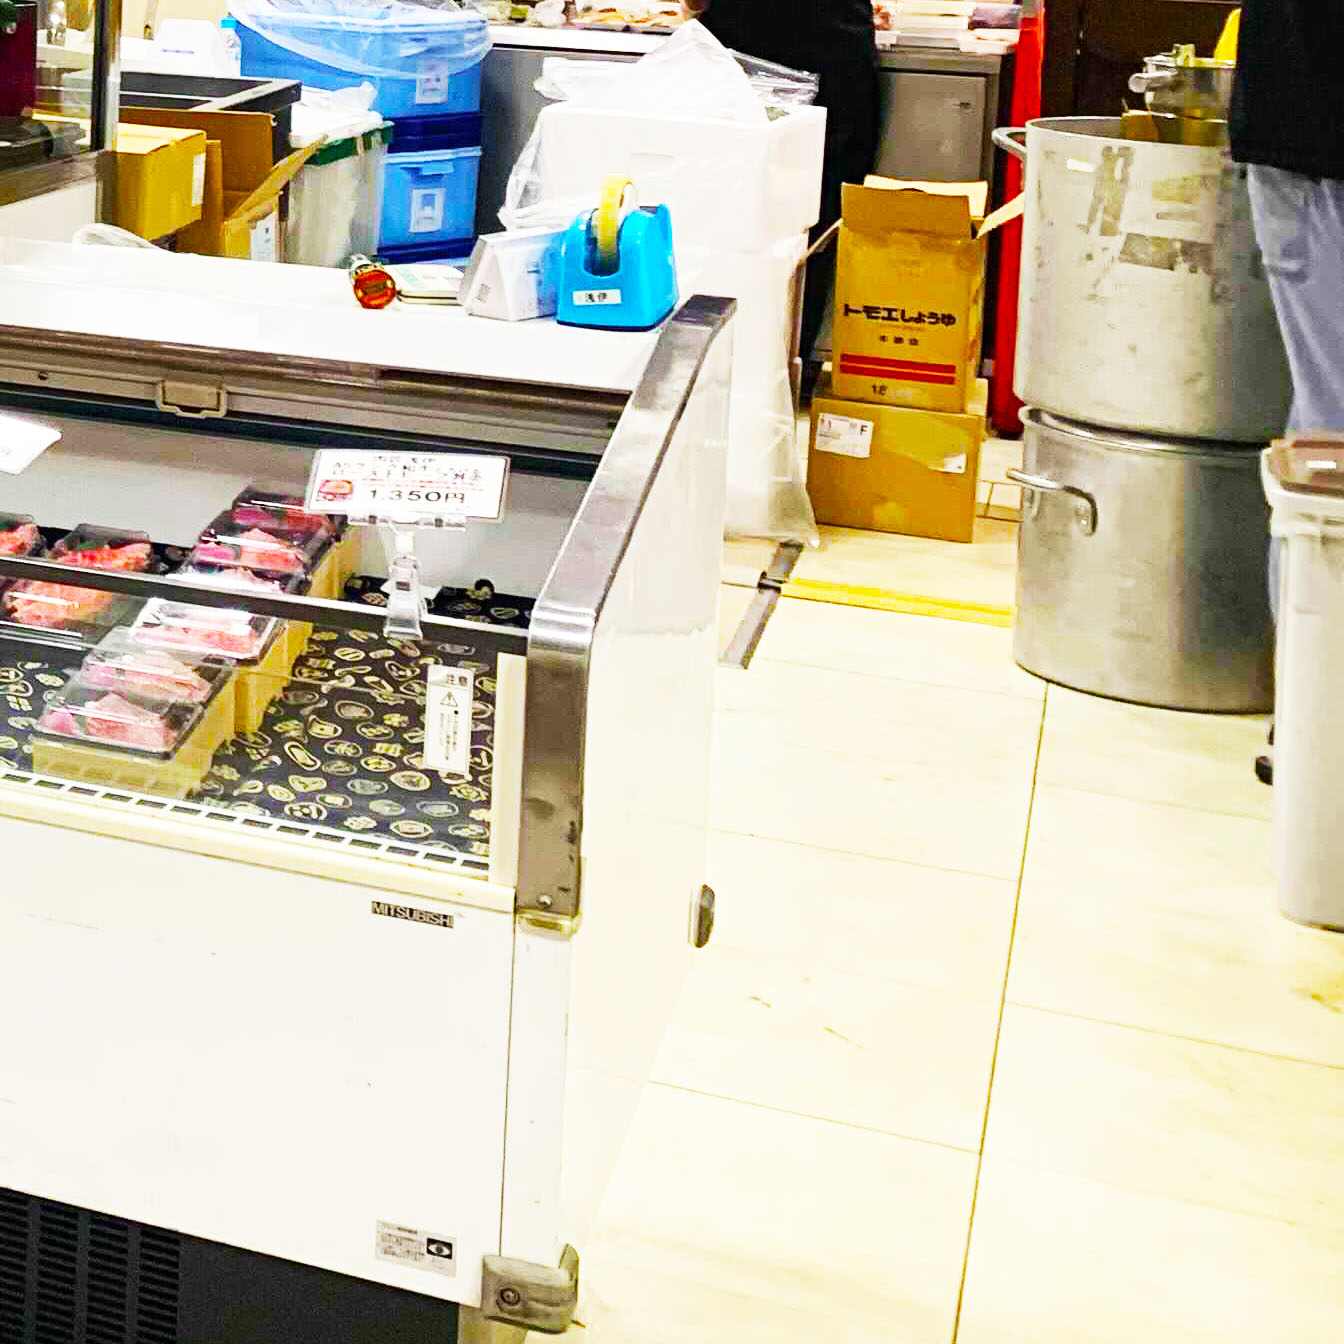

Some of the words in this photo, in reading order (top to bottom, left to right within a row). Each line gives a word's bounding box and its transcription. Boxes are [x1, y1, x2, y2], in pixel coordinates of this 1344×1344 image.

[844, 303, 958, 327] トモエしょうゆ
